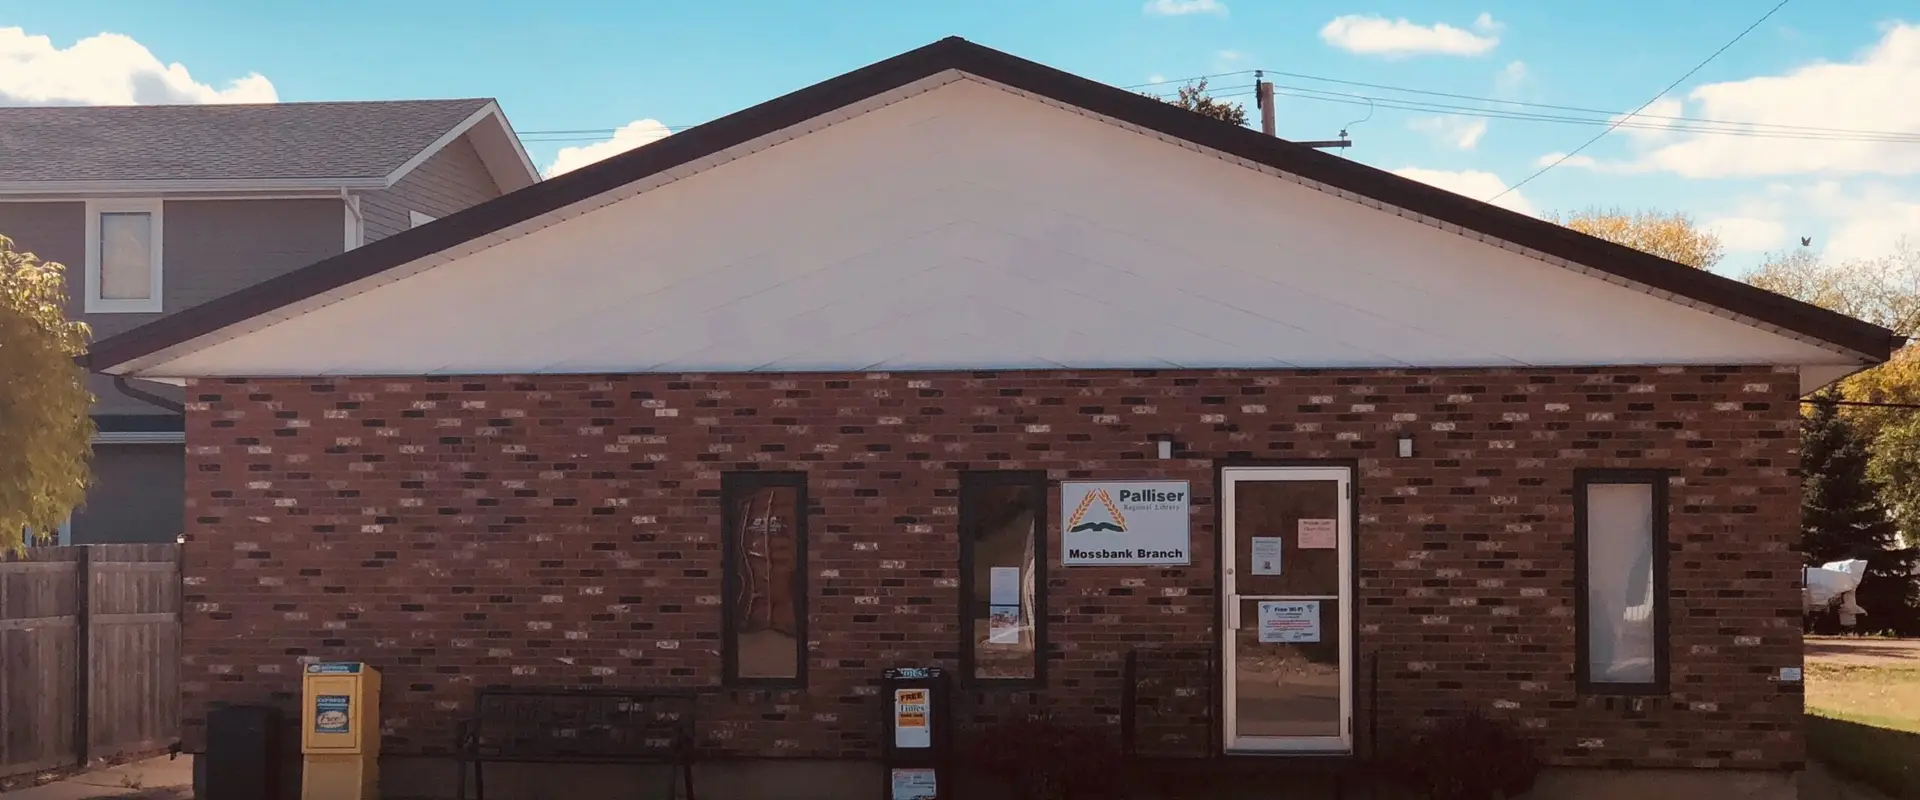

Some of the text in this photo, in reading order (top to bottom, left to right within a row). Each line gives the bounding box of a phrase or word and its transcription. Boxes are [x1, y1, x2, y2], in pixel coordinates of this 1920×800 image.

[1119, 489, 1184, 502] Palliser
[1123, 503, 1180, 511] Regional Library
[1069, 549, 1183, 559] Mossbank Branch
[900, 692, 923, 701] FREE
